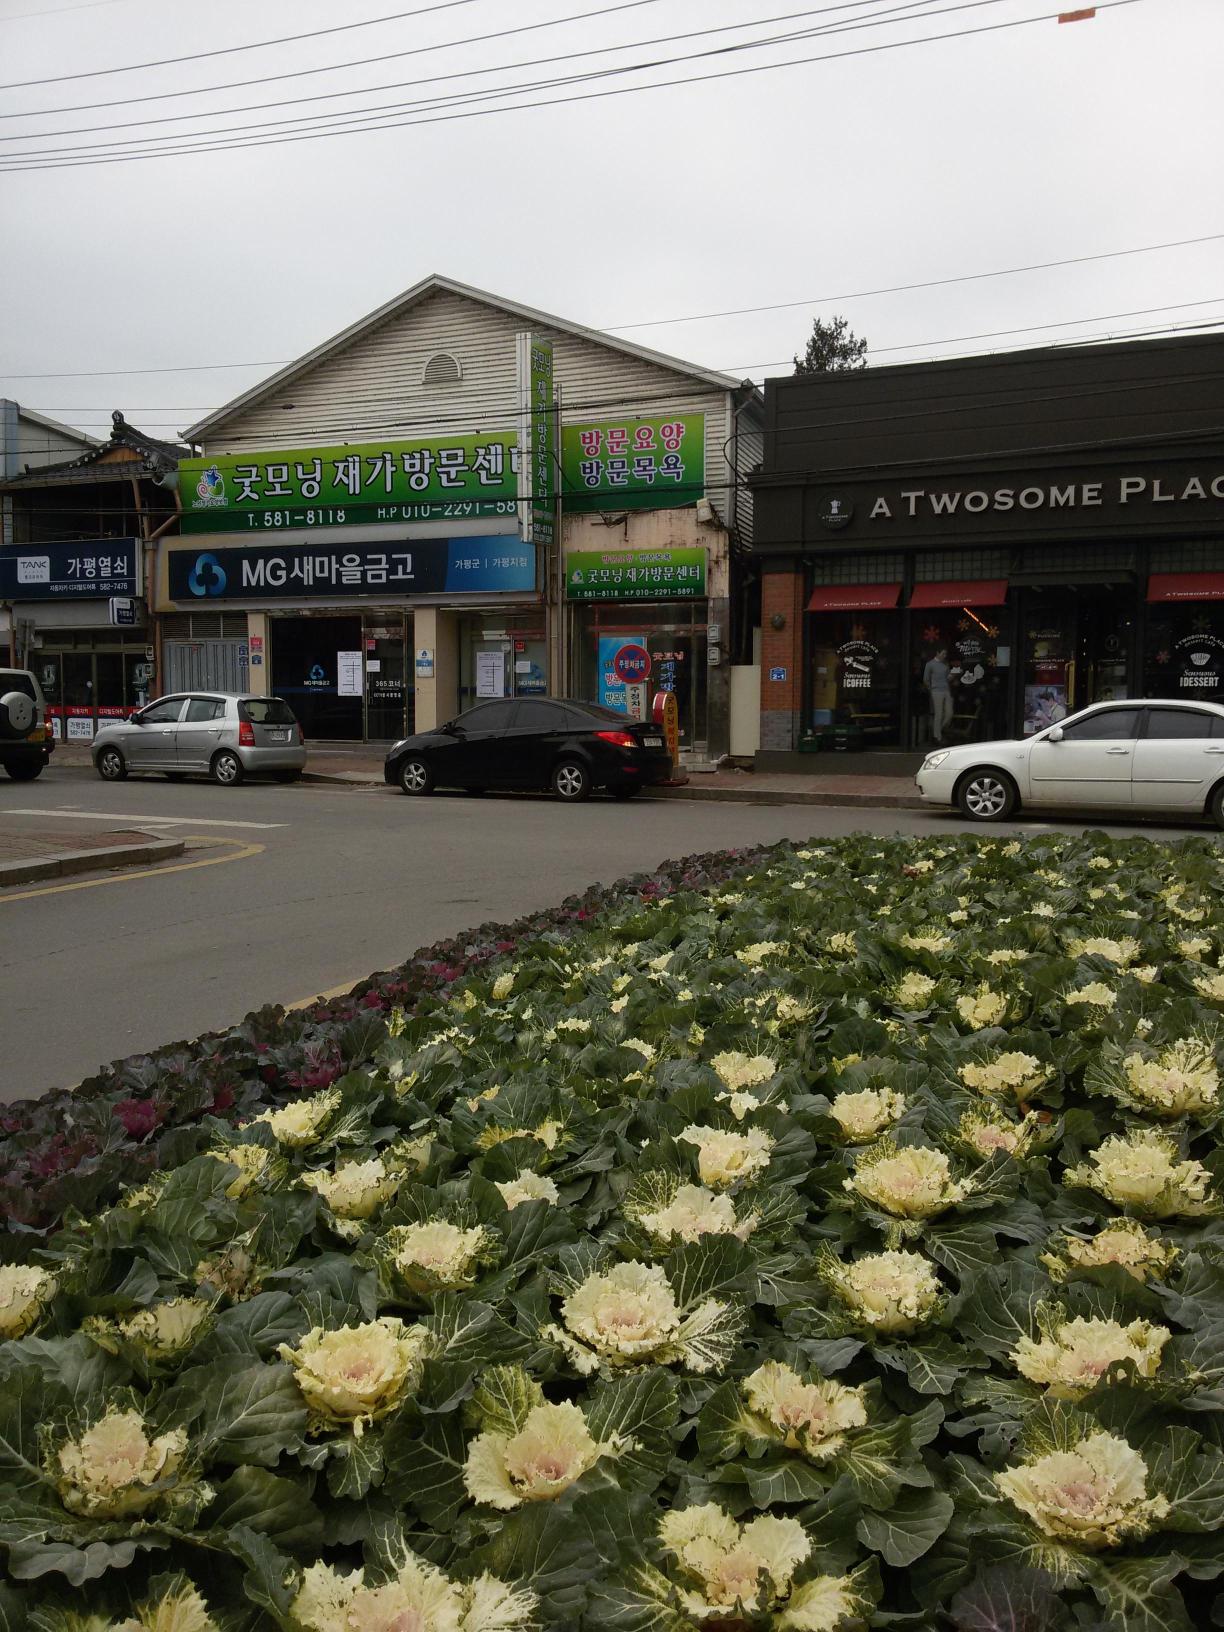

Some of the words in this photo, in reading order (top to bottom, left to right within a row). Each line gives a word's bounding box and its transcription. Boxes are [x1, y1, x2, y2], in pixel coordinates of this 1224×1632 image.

[580, 423, 685, 457] 방문요양
[232, 457, 322, 502] 굿모닝
[580, 453, 685, 487] 방문목욕
[869, 497, 892, 518] A
[1119, 476, 1224, 504] PLAC
[264, 510, 346, 527] 581-8118
[402, 500, 516, 519] 010-2291-58
[20, 561, 47, 569] TANK
[67, 555, 128, 578] 가평열쇠
[455, 559, 480, 569] 가평군
[846, 678, 872, 688] COFFEE
[1184, 677, 1220, 687] DESSERT
